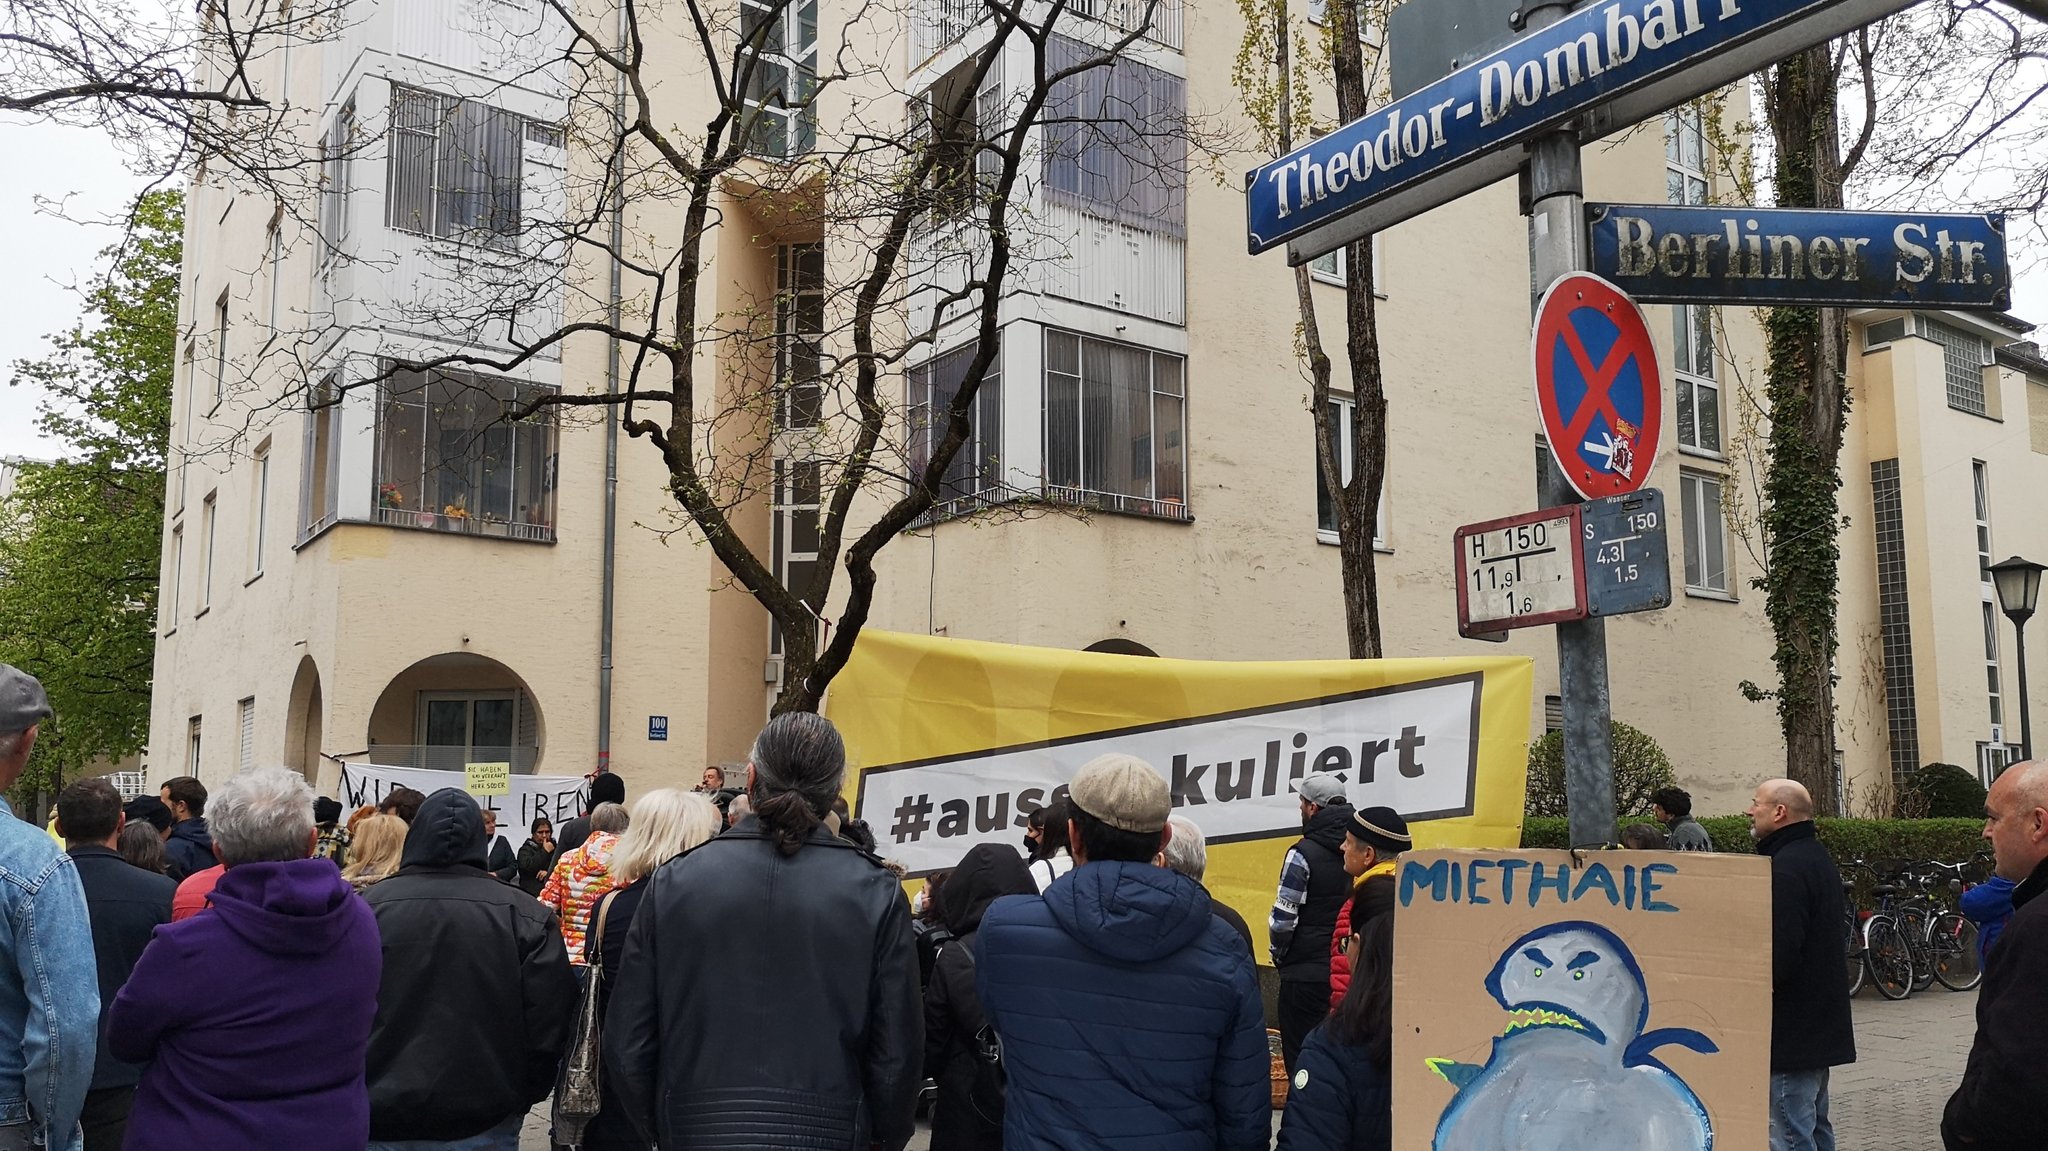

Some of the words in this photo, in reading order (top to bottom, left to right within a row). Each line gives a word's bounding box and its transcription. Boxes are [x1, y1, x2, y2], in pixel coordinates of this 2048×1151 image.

[1612, 216, 1870, 281] Berliner
[1892, 222, 1993, 284] Str.
[1606, 494, 1631, 504] Wasser
[1585, 523, 1595, 540] S
[1627, 512, 1657, 532] 150
[1472, 534, 1485, 558] H
[1505, 523, 1546, 552] 150
[1596, 546, 1620, 564] 4,3
[1473, 566, 1513, 592] 11,9
[1615, 564, 1638, 583] 1,5
[1506, 591, 1532, 615] 1,6
[651, 717, 666, 729] 100
[1400, 859, 1680, 912] MIETHAIE
